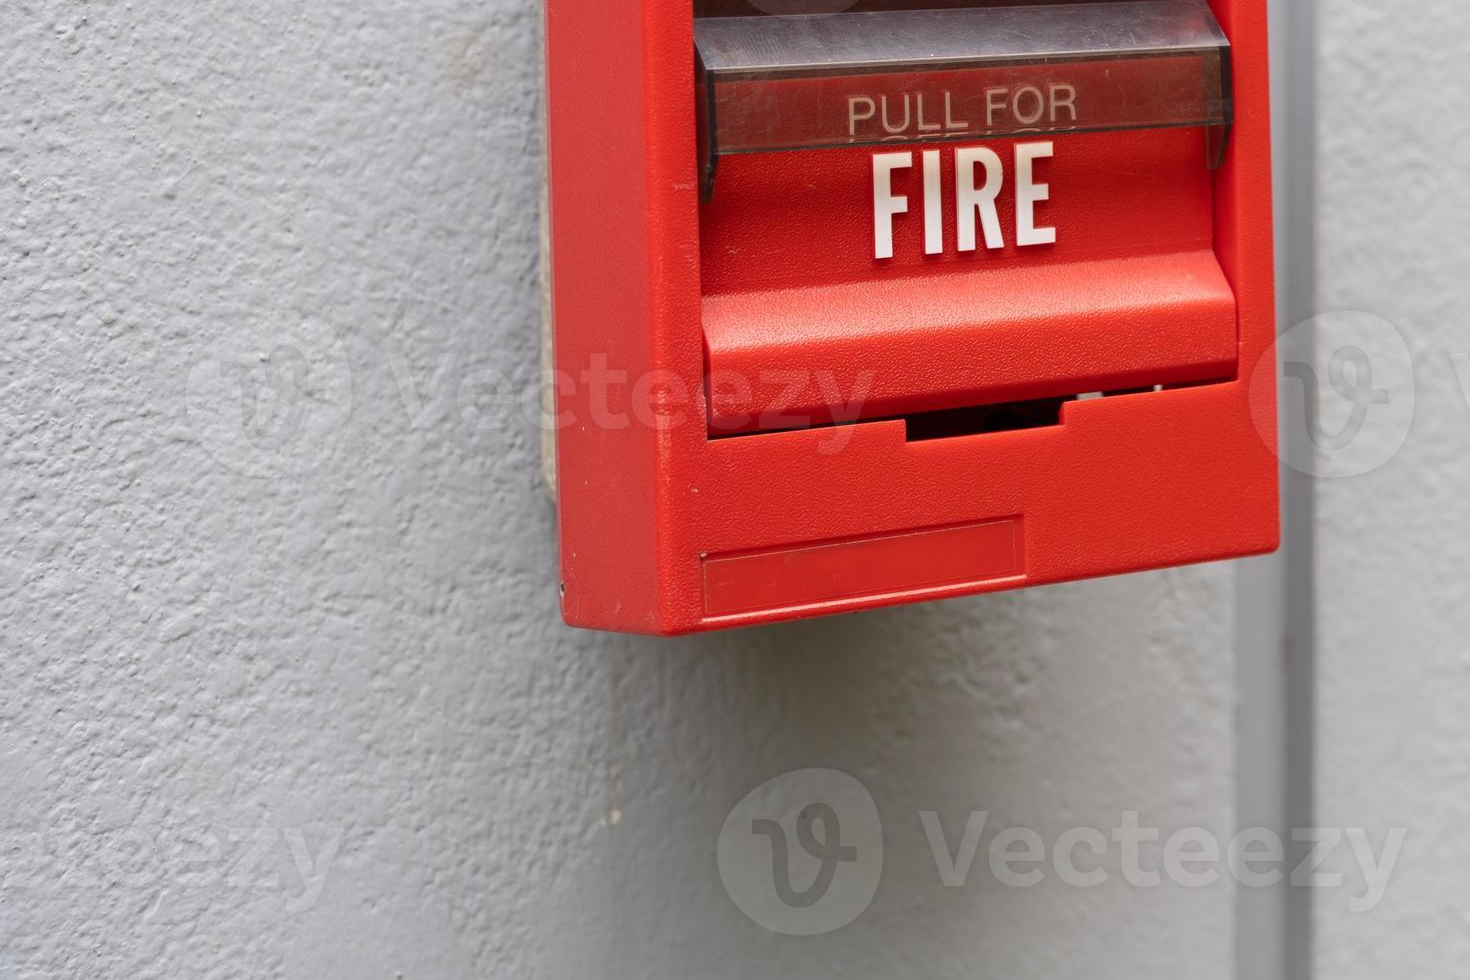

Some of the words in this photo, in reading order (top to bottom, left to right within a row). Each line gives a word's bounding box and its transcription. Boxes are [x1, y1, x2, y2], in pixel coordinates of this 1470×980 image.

[847, 90, 969, 136] PULL
[985, 83, 1077, 127] FOR
[872, 141, 1057, 260] FIRE
